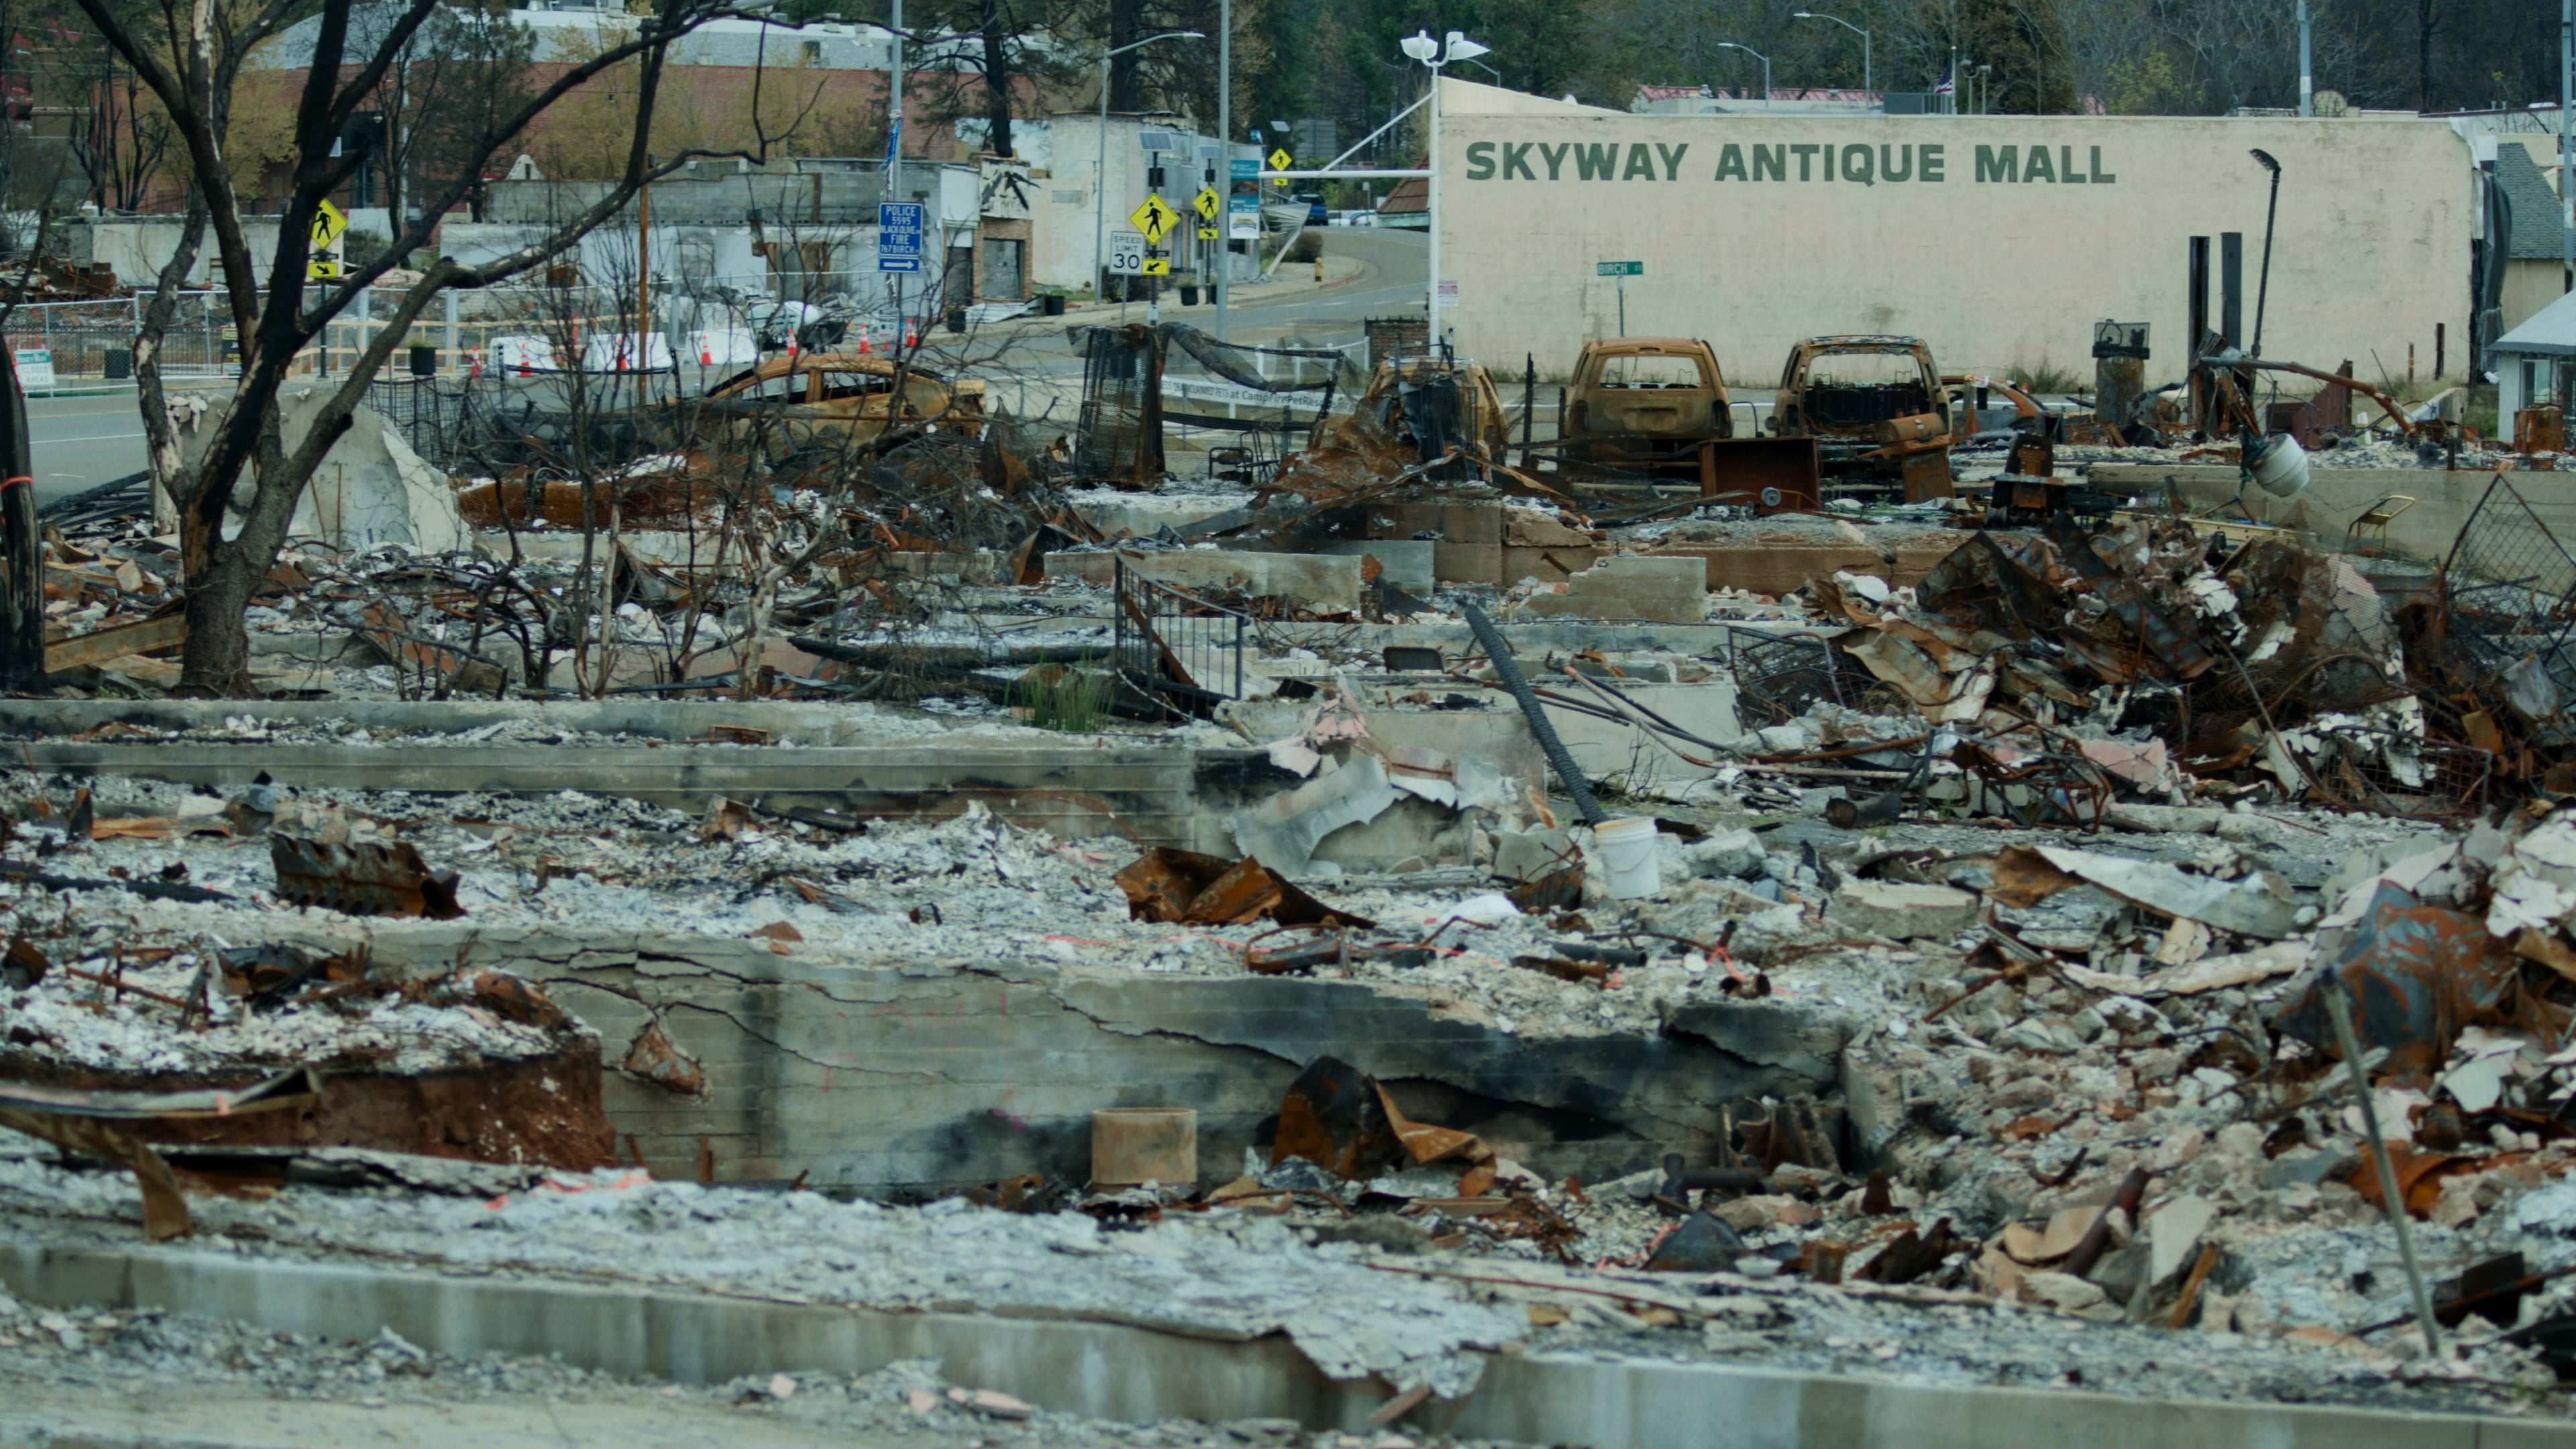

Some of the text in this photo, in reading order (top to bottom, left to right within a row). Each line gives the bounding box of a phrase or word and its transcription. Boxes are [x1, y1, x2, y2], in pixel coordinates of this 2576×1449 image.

[1465, 142, 2116, 188] SKYWAY ANTIQUE MALL
[886, 205, 916, 217] POLICE
[892, 216, 912, 225] 5595
[890, 234, 910, 245] FIRE
[1114, 235, 1142, 244] SPEED
[881, 245, 892, 253] 767
[893, 245, 915, 254] BIRCH
[1114, 253, 1140, 270] 30
[1599, 263, 1628, 274] BIRCH
[1230, 390, 1240, 399] at
